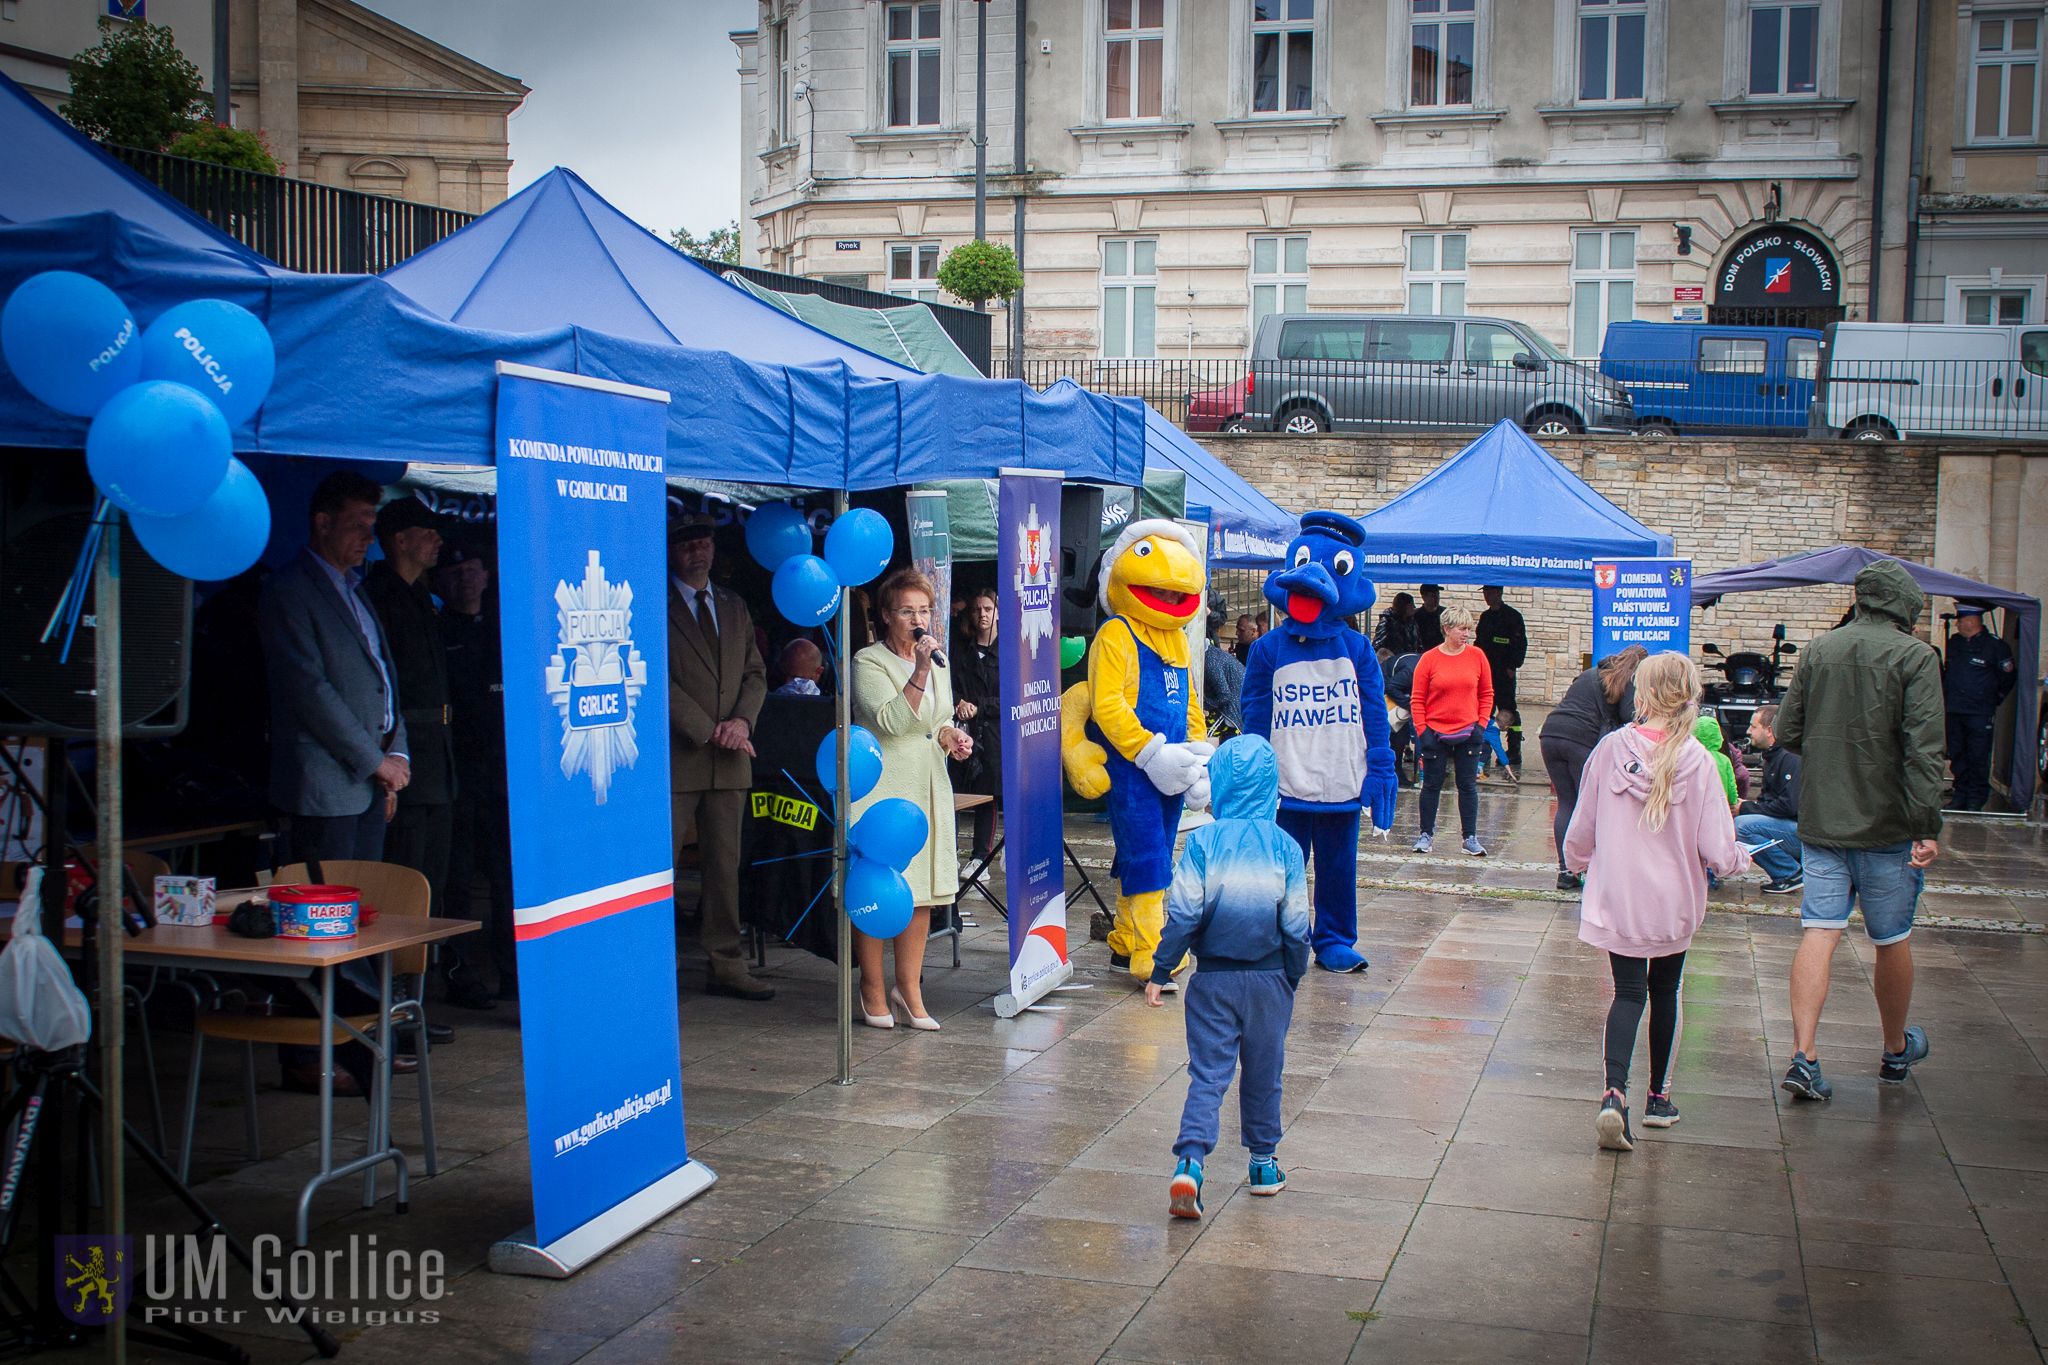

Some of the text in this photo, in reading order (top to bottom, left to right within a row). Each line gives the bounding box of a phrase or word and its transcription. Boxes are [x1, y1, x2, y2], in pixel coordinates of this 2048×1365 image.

[1724, 264, 1740, 291] DOM
[1736, 236, 1782, 263] POLSKO
[1793, 240, 1832, 291] SŁOWACKI
[174, 327, 233, 395] POLICJA
[508, 438, 663, 473] KOMENDA POWIATOWA POLICJI
[556, 479, 628, 502] W GORLICACH
[1401, 553, 1451, 565] Powiatowa
[1453, 554, 1509, 567] Państwowej
[1511, 555, 1540, 568] Straży
[1542, 557, 1583, 570] Pożarnej
[1584, 560, 1592, 569] w
[1621, 573, 1663, 584] KOMENDA
[1024, 587, 1048, 606] POLICJA
[1616, 587, 1667, 598] POWIATOWA
[1613, 600, 1670, 612] PAŃSTWOWEJ
[571, 613, 623, 639] POLICJA
[1602, 614, 1680, 626] STRAŻY POŻARNEJ
[1611, 630, 1670, 641] W GORLICACH
[1023, 680, 1051, 698] KOMENDA
[579, 693, 619, 717] GORLICE
[1025, 716, 1057, 737] GORLICACH
[754, 795, 814, 827] POLICJA
[310, 905, 352, 918] HARIBO
[554, 1079, 672, 1153] www.gorlice.policja.gov.pl
